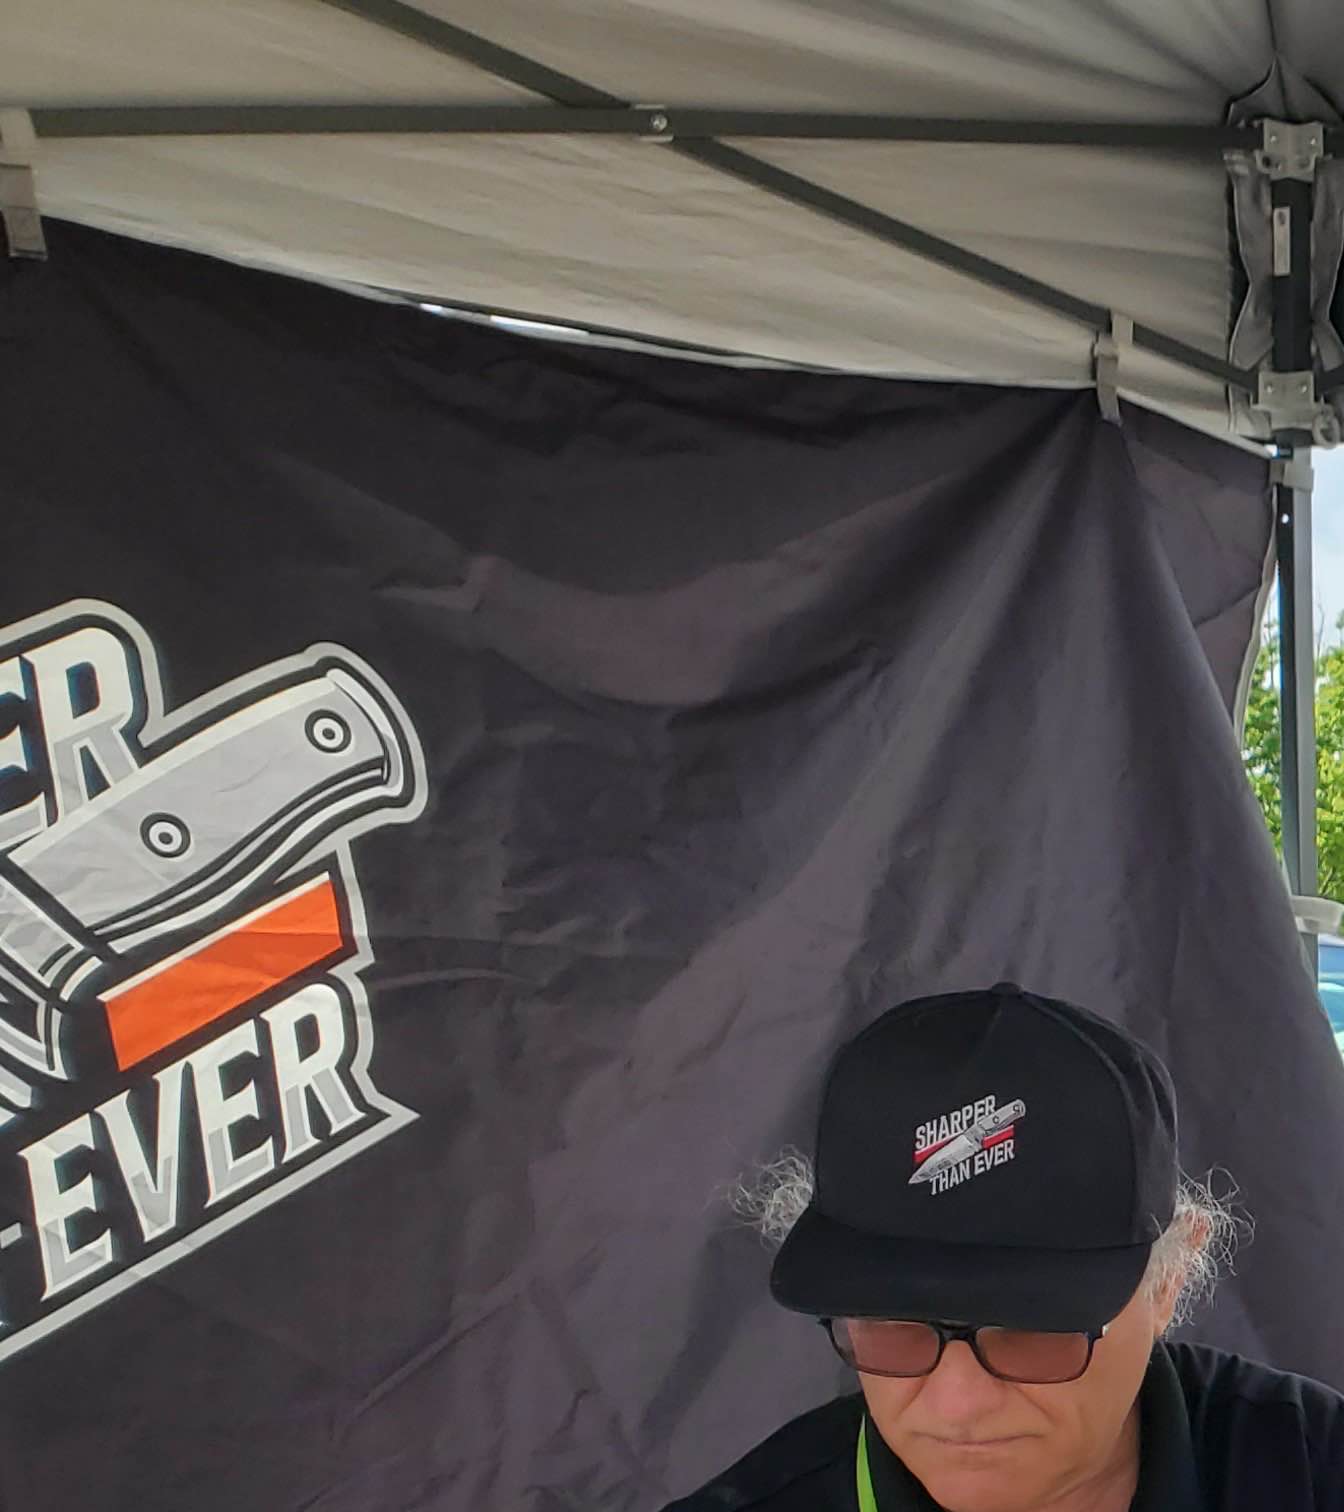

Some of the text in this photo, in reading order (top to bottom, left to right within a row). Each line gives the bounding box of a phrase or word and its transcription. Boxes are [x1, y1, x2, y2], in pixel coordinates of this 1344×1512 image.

[18, 984, 366, 1302] EVER
[915, 1095, 997, 1150] SHARPER
[930, 1140, 1015, 1195] THAN EVER
